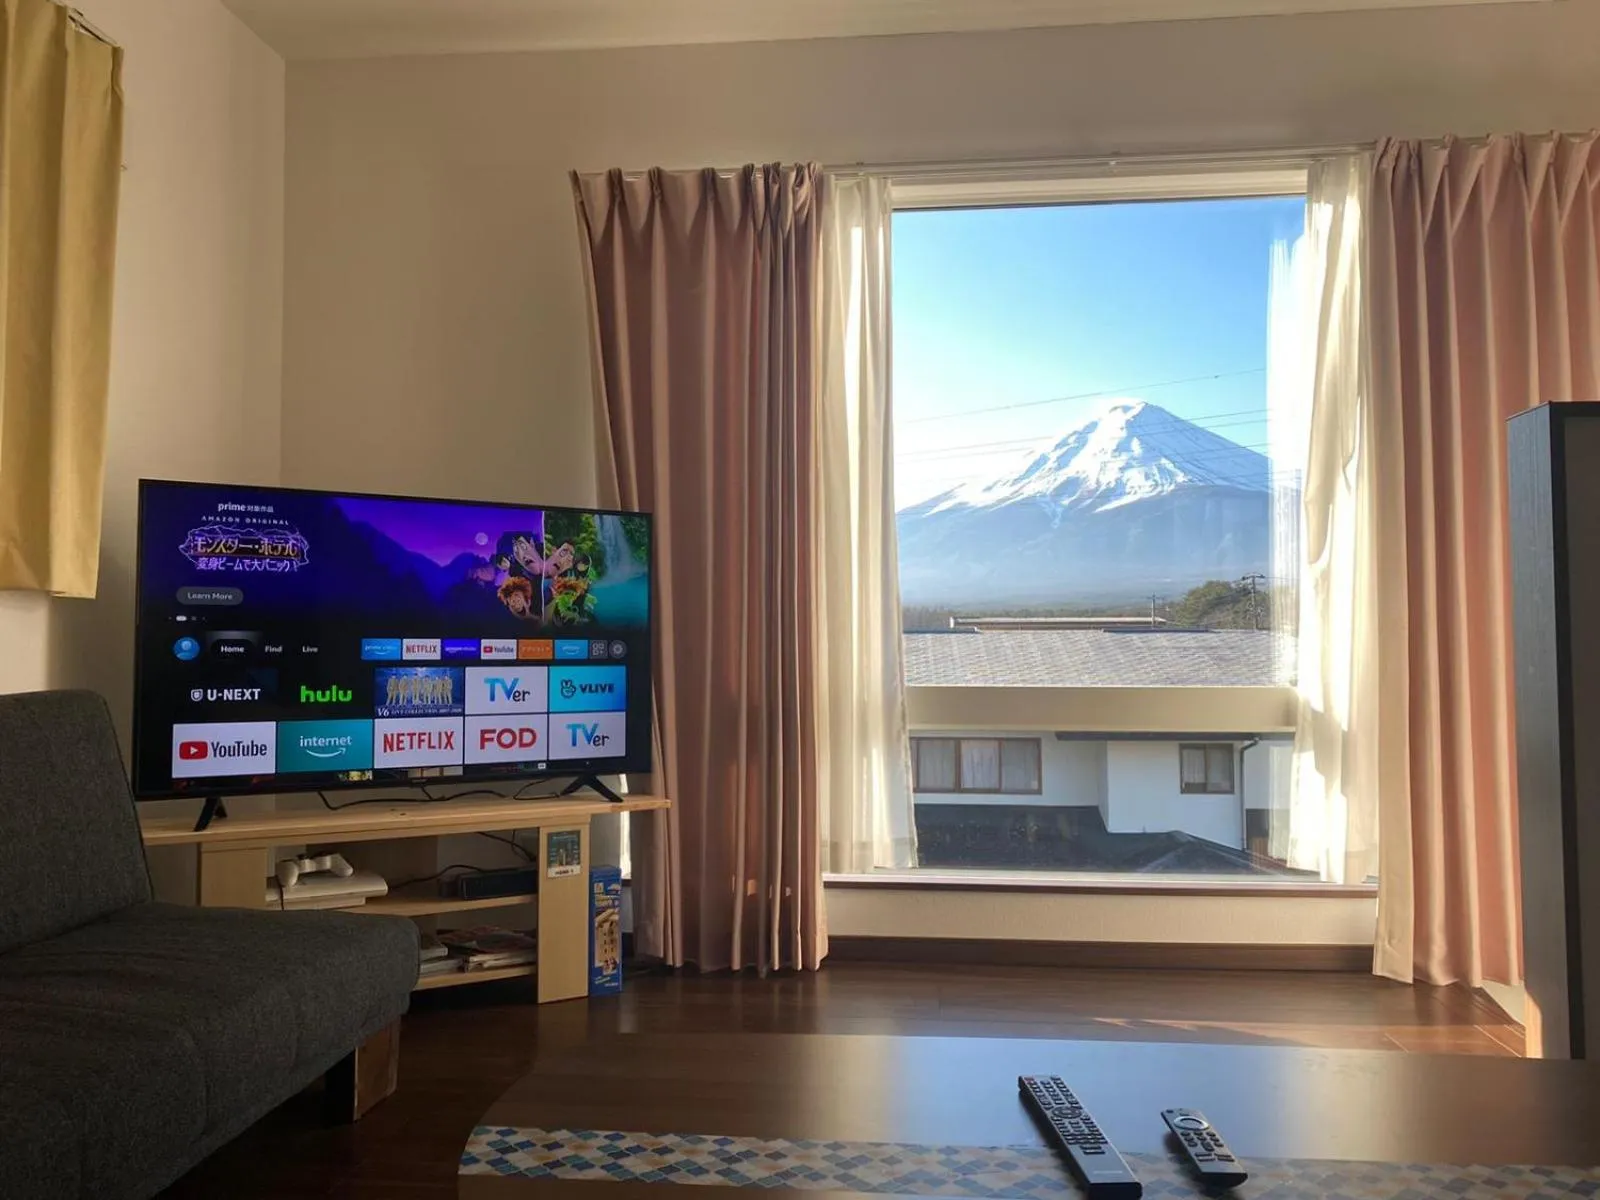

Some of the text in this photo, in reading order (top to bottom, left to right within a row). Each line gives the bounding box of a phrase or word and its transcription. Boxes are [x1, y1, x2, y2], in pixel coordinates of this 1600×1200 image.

[218, 502, 246, 512] prime
[202, 515, 289, 526] AMAZON ORIGINAL
[187, 592, 233, 601] Learn More
[220, 645, 245, 653] Home
[265, 645, 283, 653] Find
[302, 645, 319, 653] Live
[406, 644, 437, 654] NETFLIX
[494, 645, 514, 653] YouTube
[207, 688, 261, 701] U-NEXT
[300, 685, 353, 702] hulu
[484, 677, 531, 702] TVer
[479, 727, 537, 750] FOD
[566, 723, 610, 747] TVer
[300, 735, 352, 748] internet
[383, 730, 455, 753] NETFLIX
[211, 740, 268, 759] YouTube
